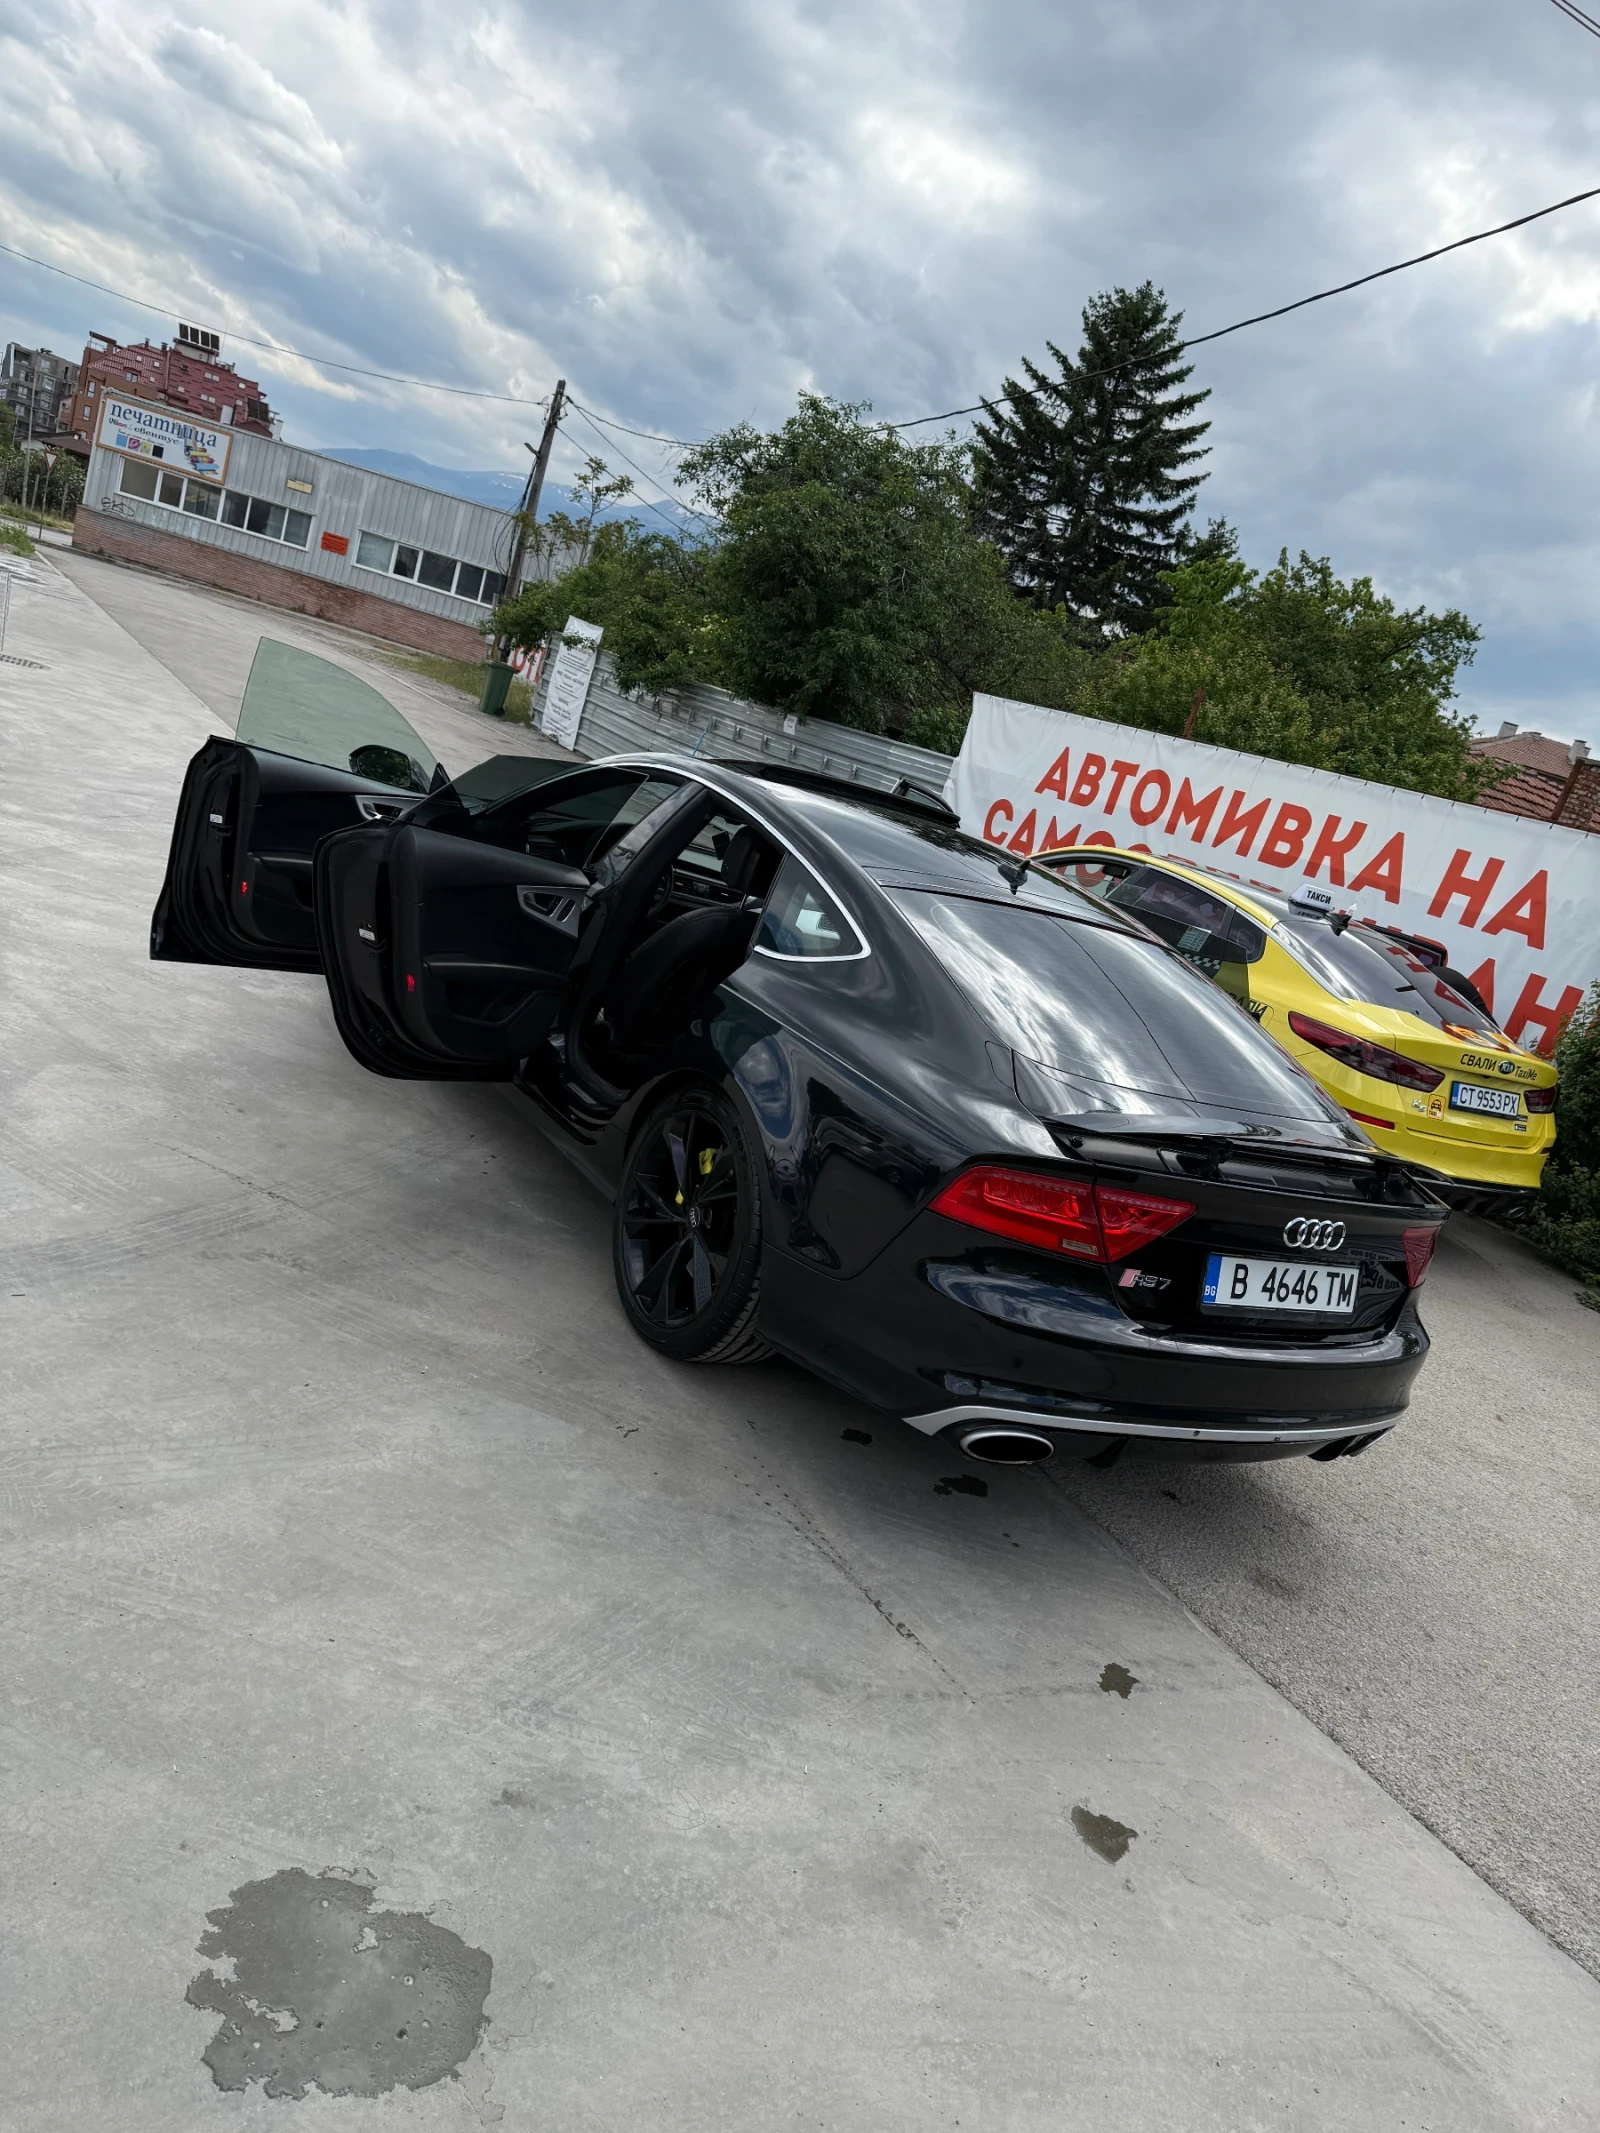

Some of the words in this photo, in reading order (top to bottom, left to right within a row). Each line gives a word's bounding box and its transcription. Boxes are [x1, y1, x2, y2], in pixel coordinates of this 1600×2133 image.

[110, 404, 217, 447] печатница
[1034, 746, 1405, 904] АВТОМИВКА
[1427, 848, 1558, 951] НА
[1307, 890, 1332, 905] ТАКСИ
[1460, 1053, 1497, 1072] СВАЛИ
[1477, 1090, 1502, 1111] 9553
[1128, 1272, 1172, 1291] RS7
[1204, 1285, 1217, 1296] BG
[1230, 1263, 1249, 1300] B
[1261, 1266, 1319, 1305] 4646
[1326, 1271, 1355, 1307] TM
